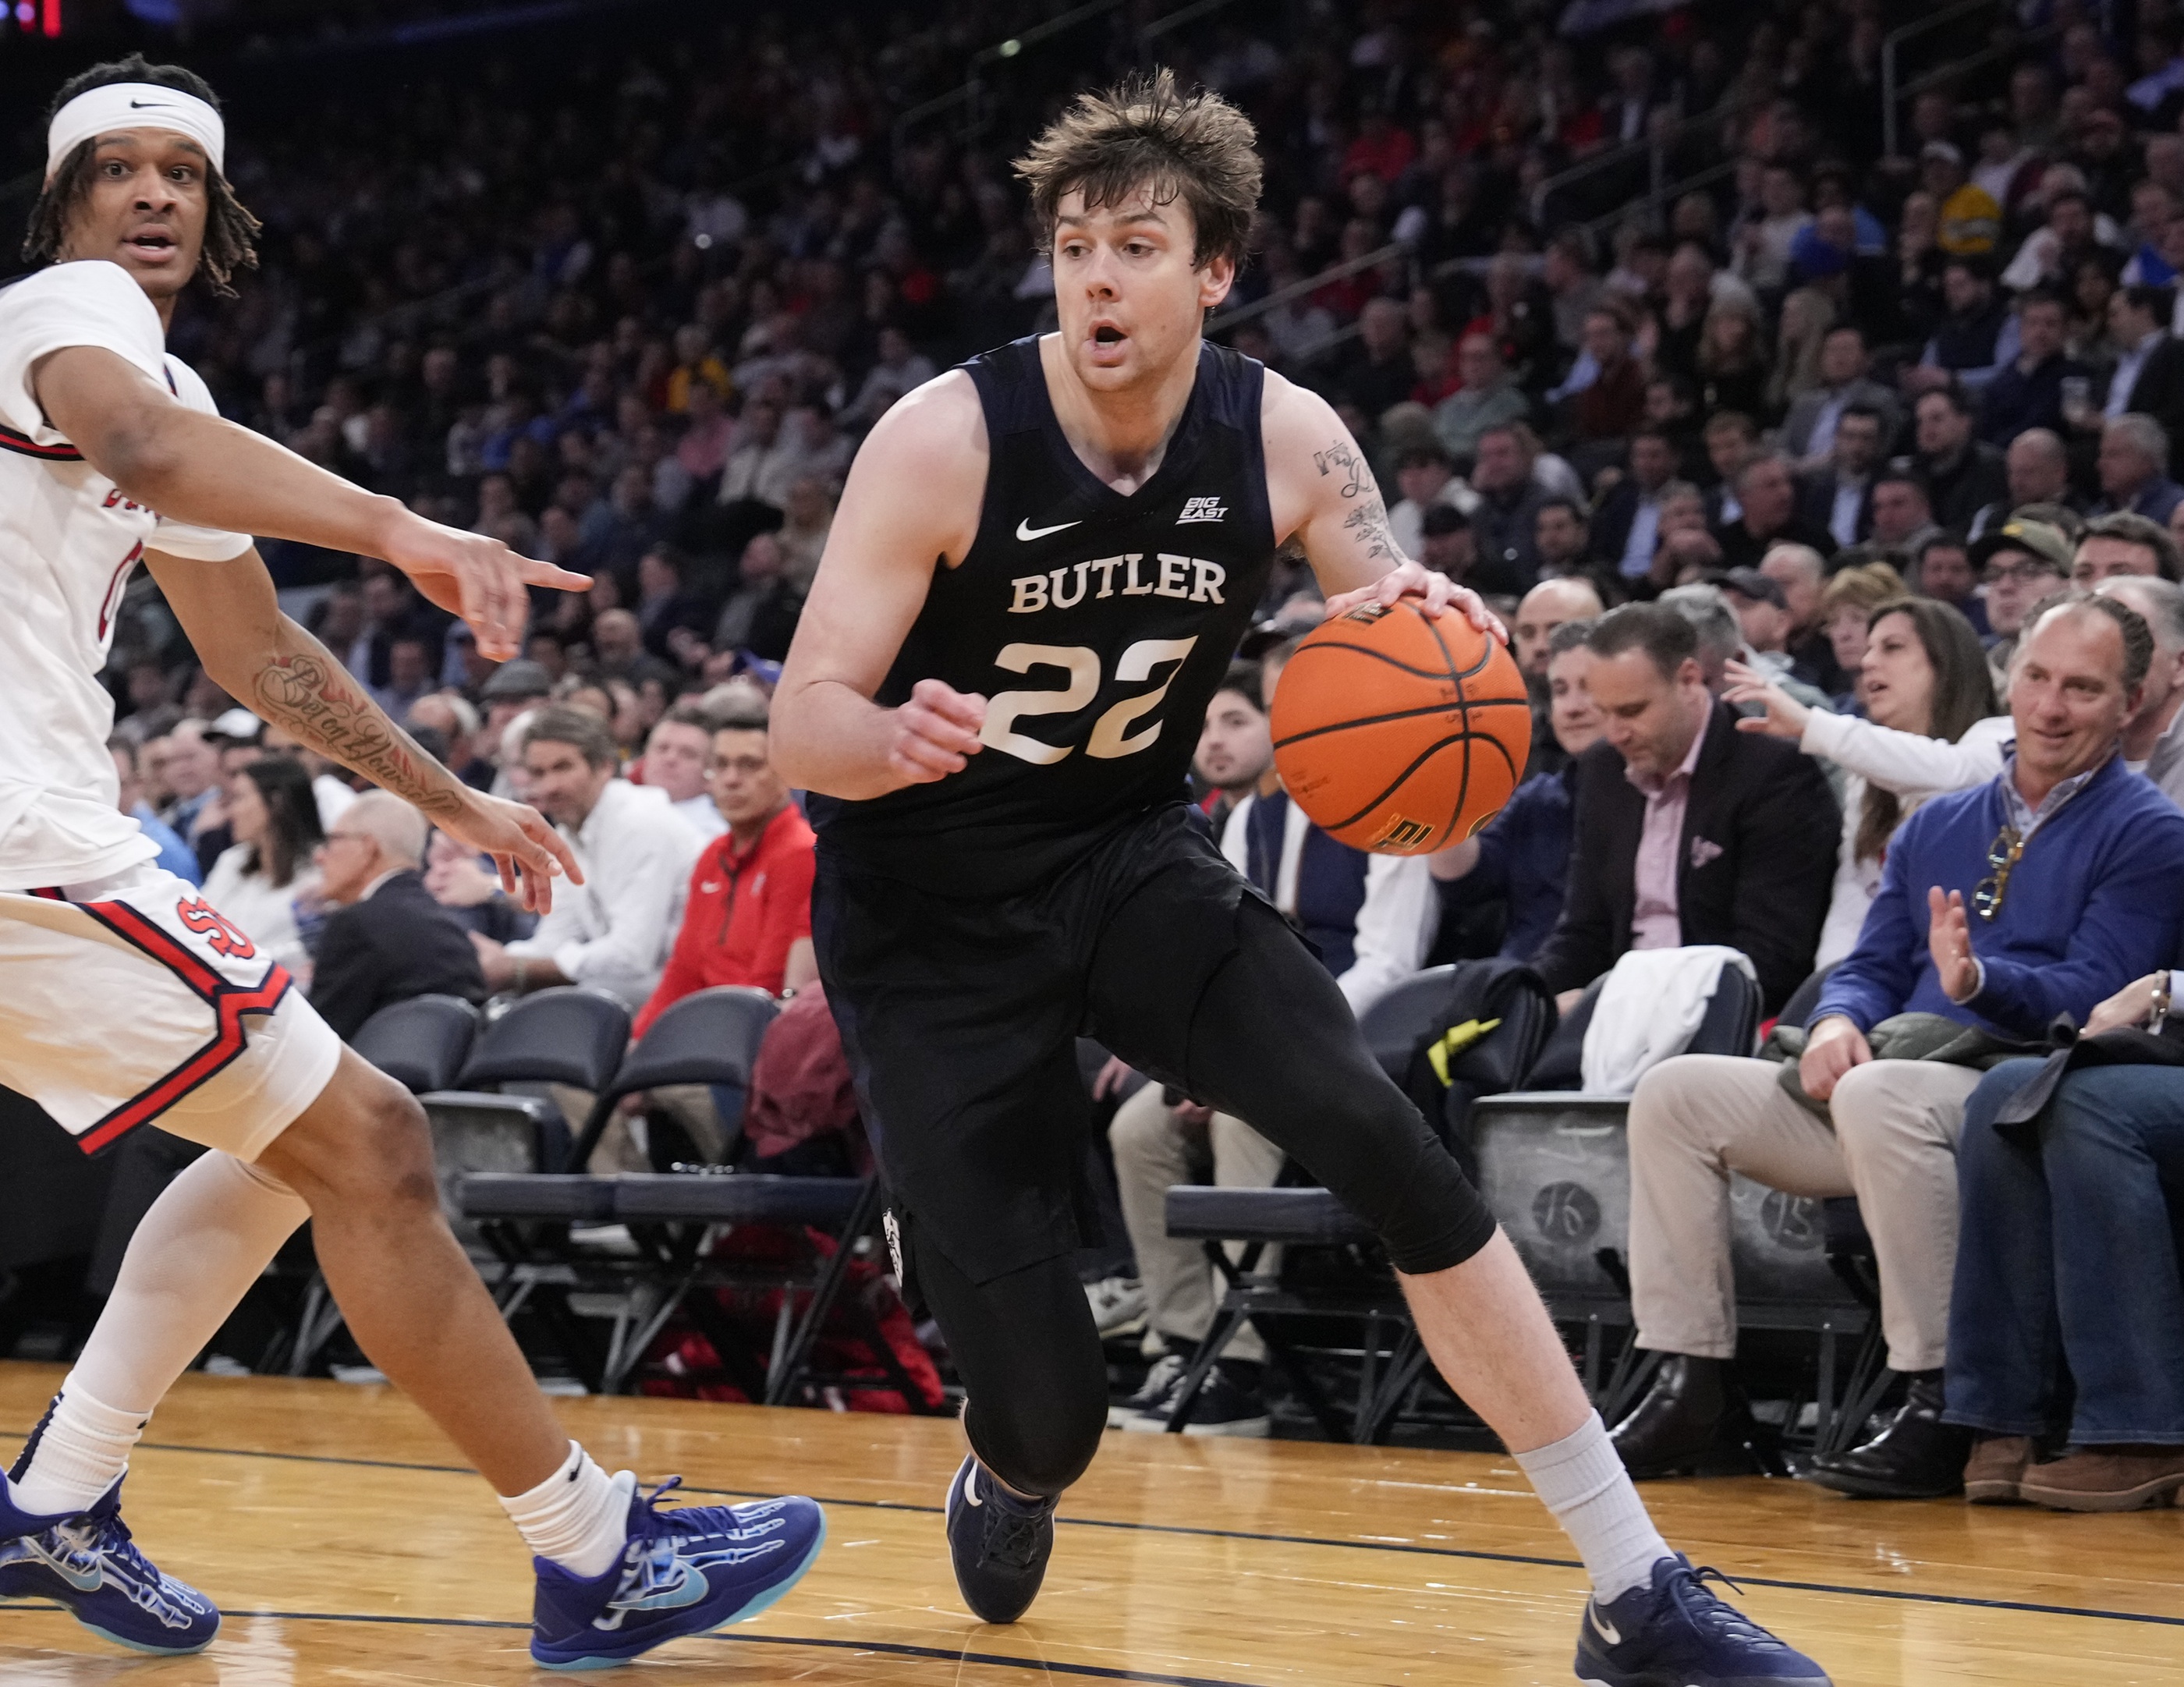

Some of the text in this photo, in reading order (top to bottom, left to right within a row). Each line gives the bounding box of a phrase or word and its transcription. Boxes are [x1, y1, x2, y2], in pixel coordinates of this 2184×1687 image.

[1179, 507, 1228, 520] EAST
[1186, 496, 1221, 509] BIG
[1007, 552, 1227, 614] BUTLER
[258, 654, 335, 722] Bet
[321, 716, 350, 744] on
[978, 634, 1200, 765] 22
